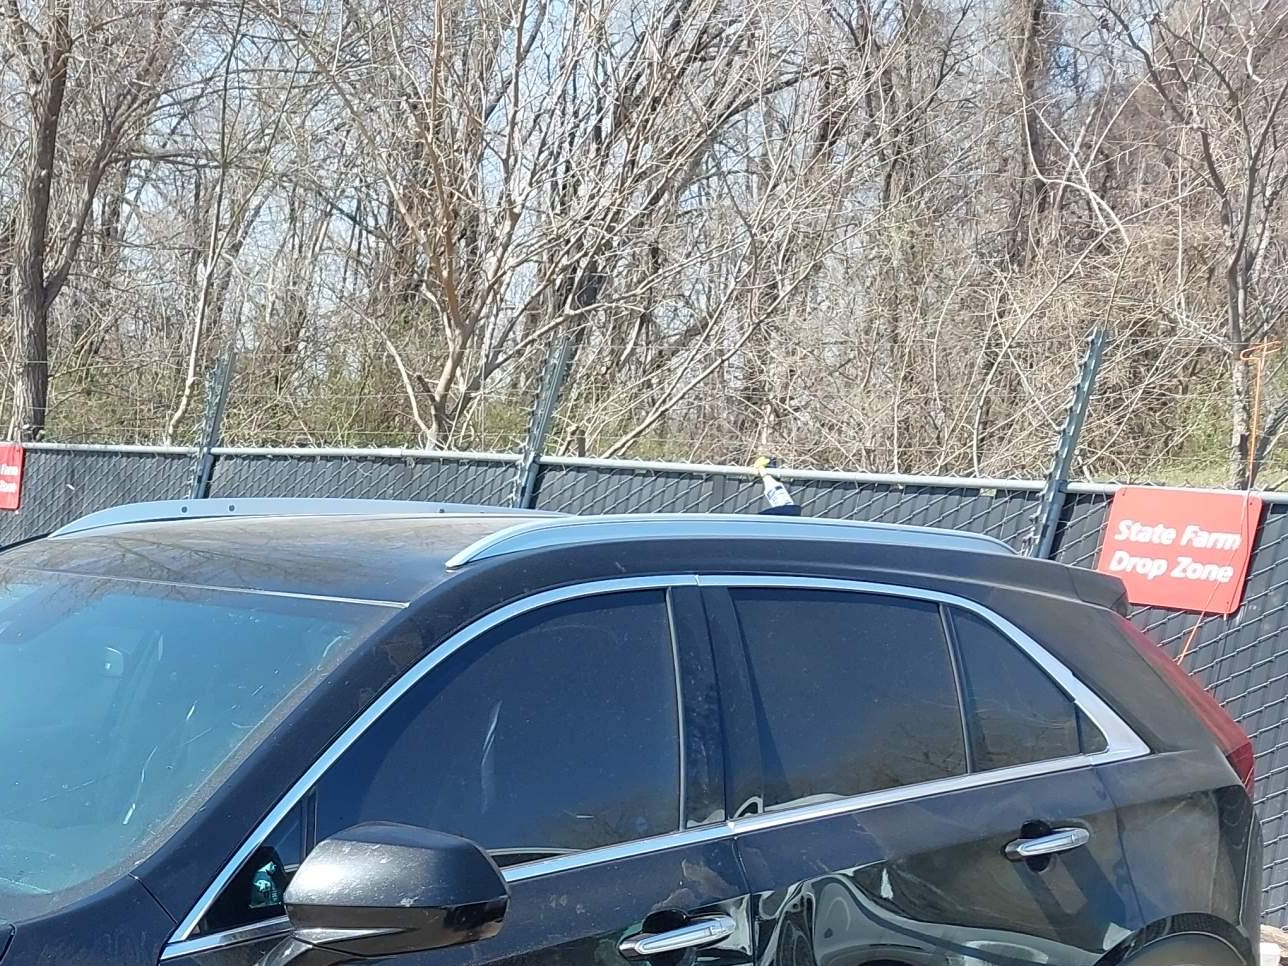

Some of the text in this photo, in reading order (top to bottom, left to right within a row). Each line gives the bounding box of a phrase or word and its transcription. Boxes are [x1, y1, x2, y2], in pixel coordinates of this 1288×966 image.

[1114, 519, 1242, 550] State Farm
[1109, 551, 1234, 583] Drop Zone
